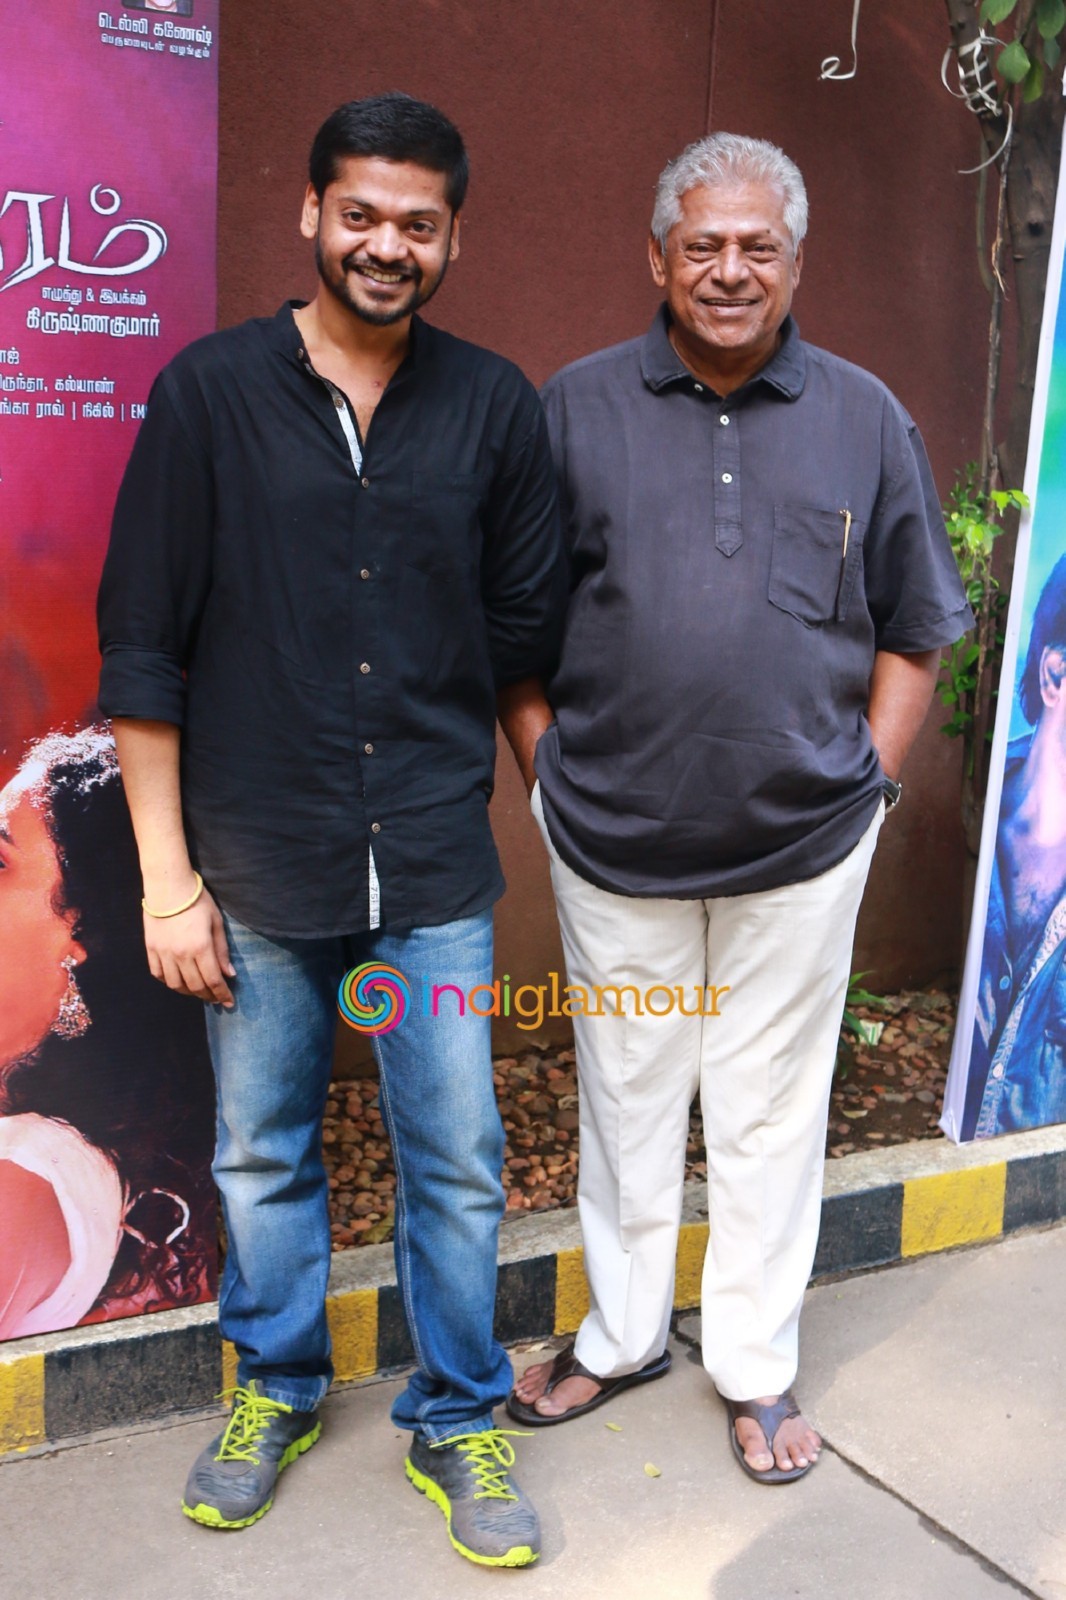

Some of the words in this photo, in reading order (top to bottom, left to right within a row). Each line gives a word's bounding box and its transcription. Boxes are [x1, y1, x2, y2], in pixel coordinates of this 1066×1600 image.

[98, 12, 149, 35] டெல்லி
[153, 21, 213, 46] கணேஷ்
[0, 183, 168, 293] ரம்
[41, 284, 82, 306] எழுத்து
[86, 287, 95, 303] &
[99, 288, 147, 306] இயக்கம்
[26, 306, 161, 338] கிருஷ்ணகுமார்
[0, 346, 20, 365] ாஜ்
[0, 372, 48, 393] ருந்தா,
[54, 374, 115, 394] கல்யாண்
[0, 397, 30, 416] ங்கா
[82, 401, 115, 419] நிகில்
[130, 403, 148, 419] EM
